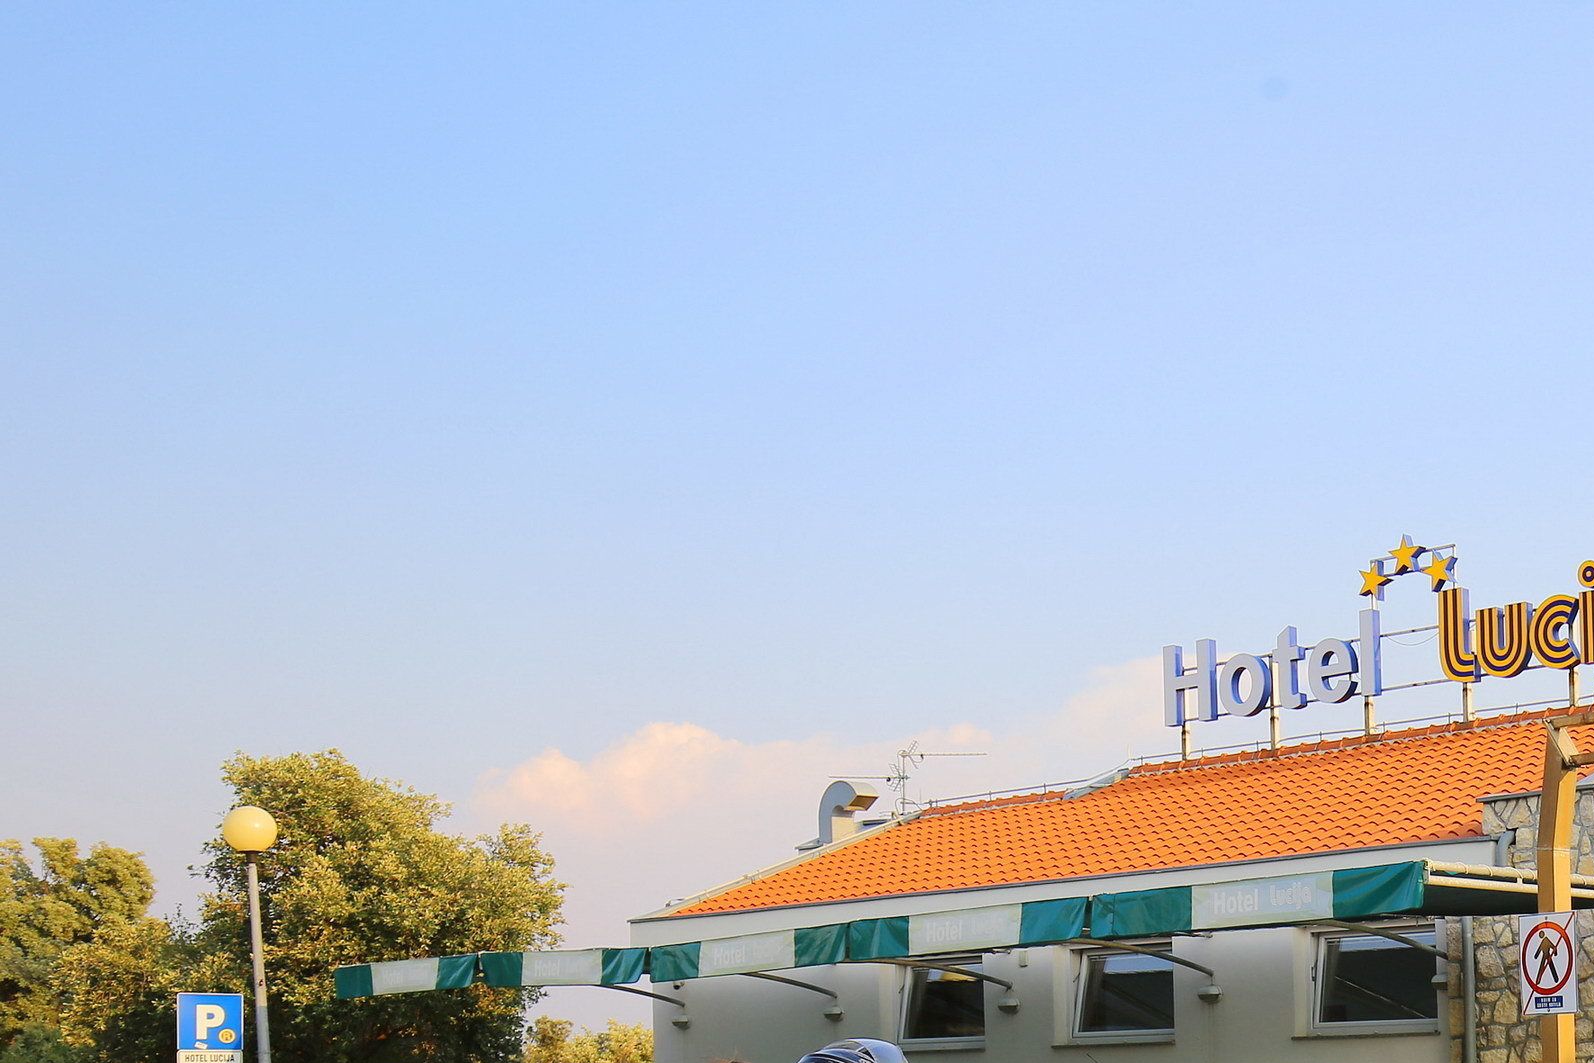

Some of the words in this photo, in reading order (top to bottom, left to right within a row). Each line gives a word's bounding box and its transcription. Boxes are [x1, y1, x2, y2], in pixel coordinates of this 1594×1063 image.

[1163, 609, 1381, 727] Hotel
[1213, 888, 1259, 915] Hotel
[925, 919, 963, 943] Hotel
[196, 1004, 225, 1040] P
[184, 1054, 208, 1062] HOTEL
[210, 1054, 235, 1062] LUCIJA
